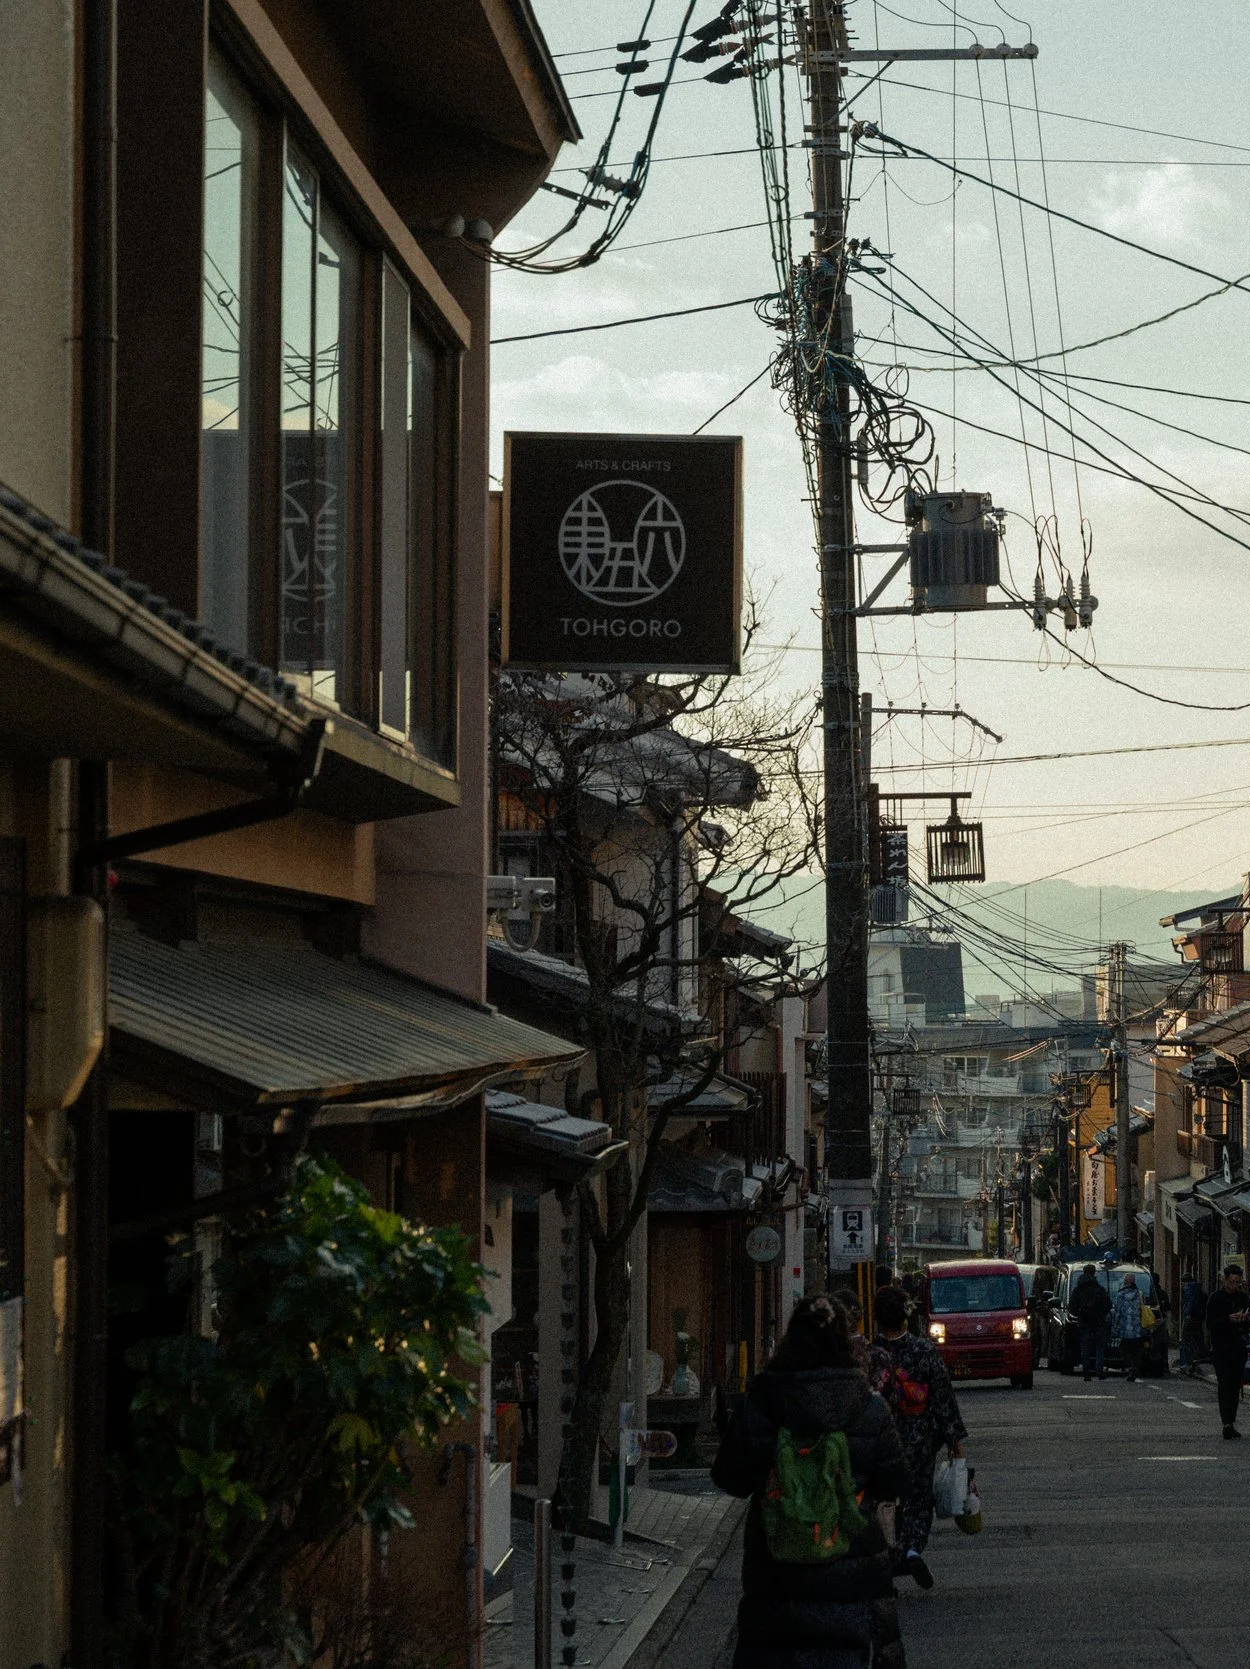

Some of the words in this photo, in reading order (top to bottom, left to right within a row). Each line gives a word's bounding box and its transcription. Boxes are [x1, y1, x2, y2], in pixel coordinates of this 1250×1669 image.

[576, 460, 610, 471] ARTS
[611, 461, 618, 471] &
[622, 460, 671, 472] CRAFTS
[560, 617, 682, 638] TOHGORO
